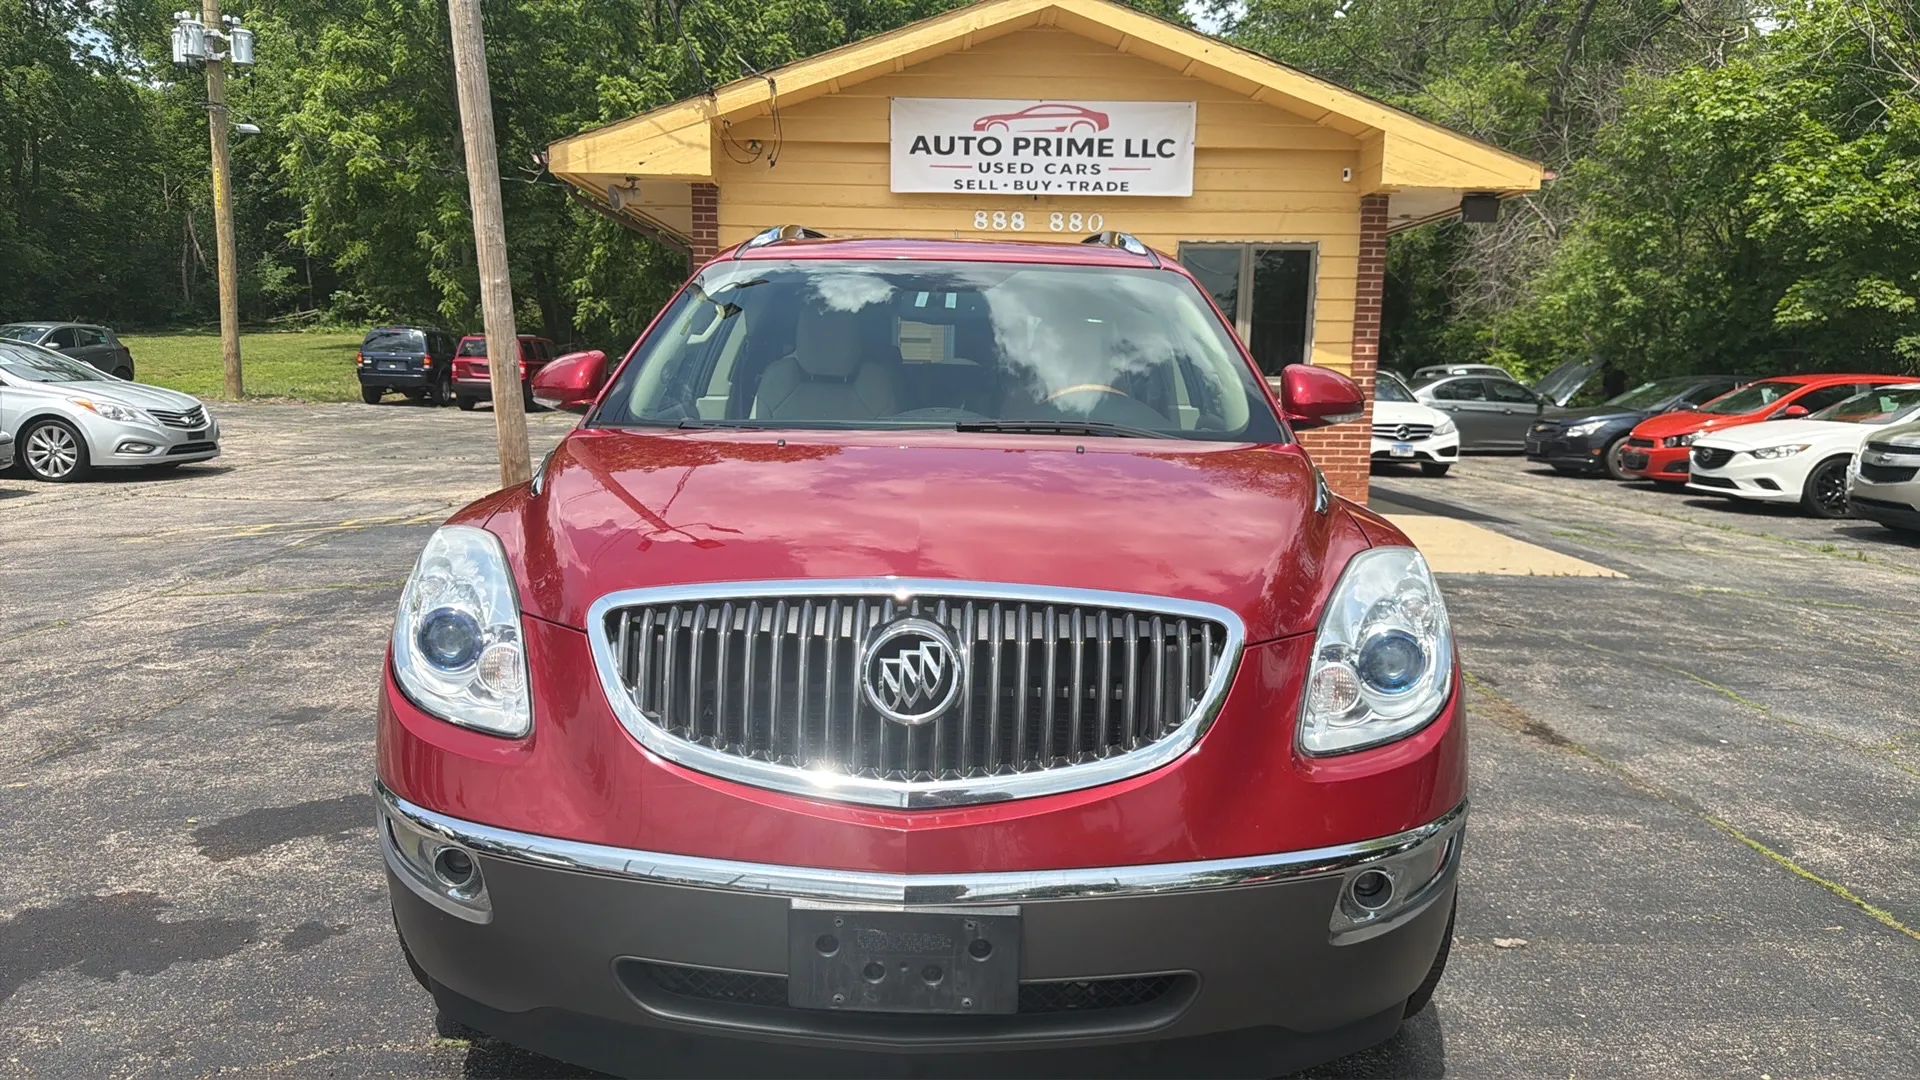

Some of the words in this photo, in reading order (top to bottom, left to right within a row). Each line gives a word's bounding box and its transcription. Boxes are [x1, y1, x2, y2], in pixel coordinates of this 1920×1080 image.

[909, 135, 1002, 156] AUTO
[1012, 137, 1114, 158] PRIME
[1124, 138, 1176, 159] LLC
[978, 162, 1034, 175] USED
[1044, 163, 1102, 175] CARS
[953, 179, 999, 191] SELL
[1013, 180, 1052, 191] BUY
[1067, 181, 1129, 192] TRADE
[973, 210, 1026, 231] 888
[1049, 211, 1104, 233] 880
